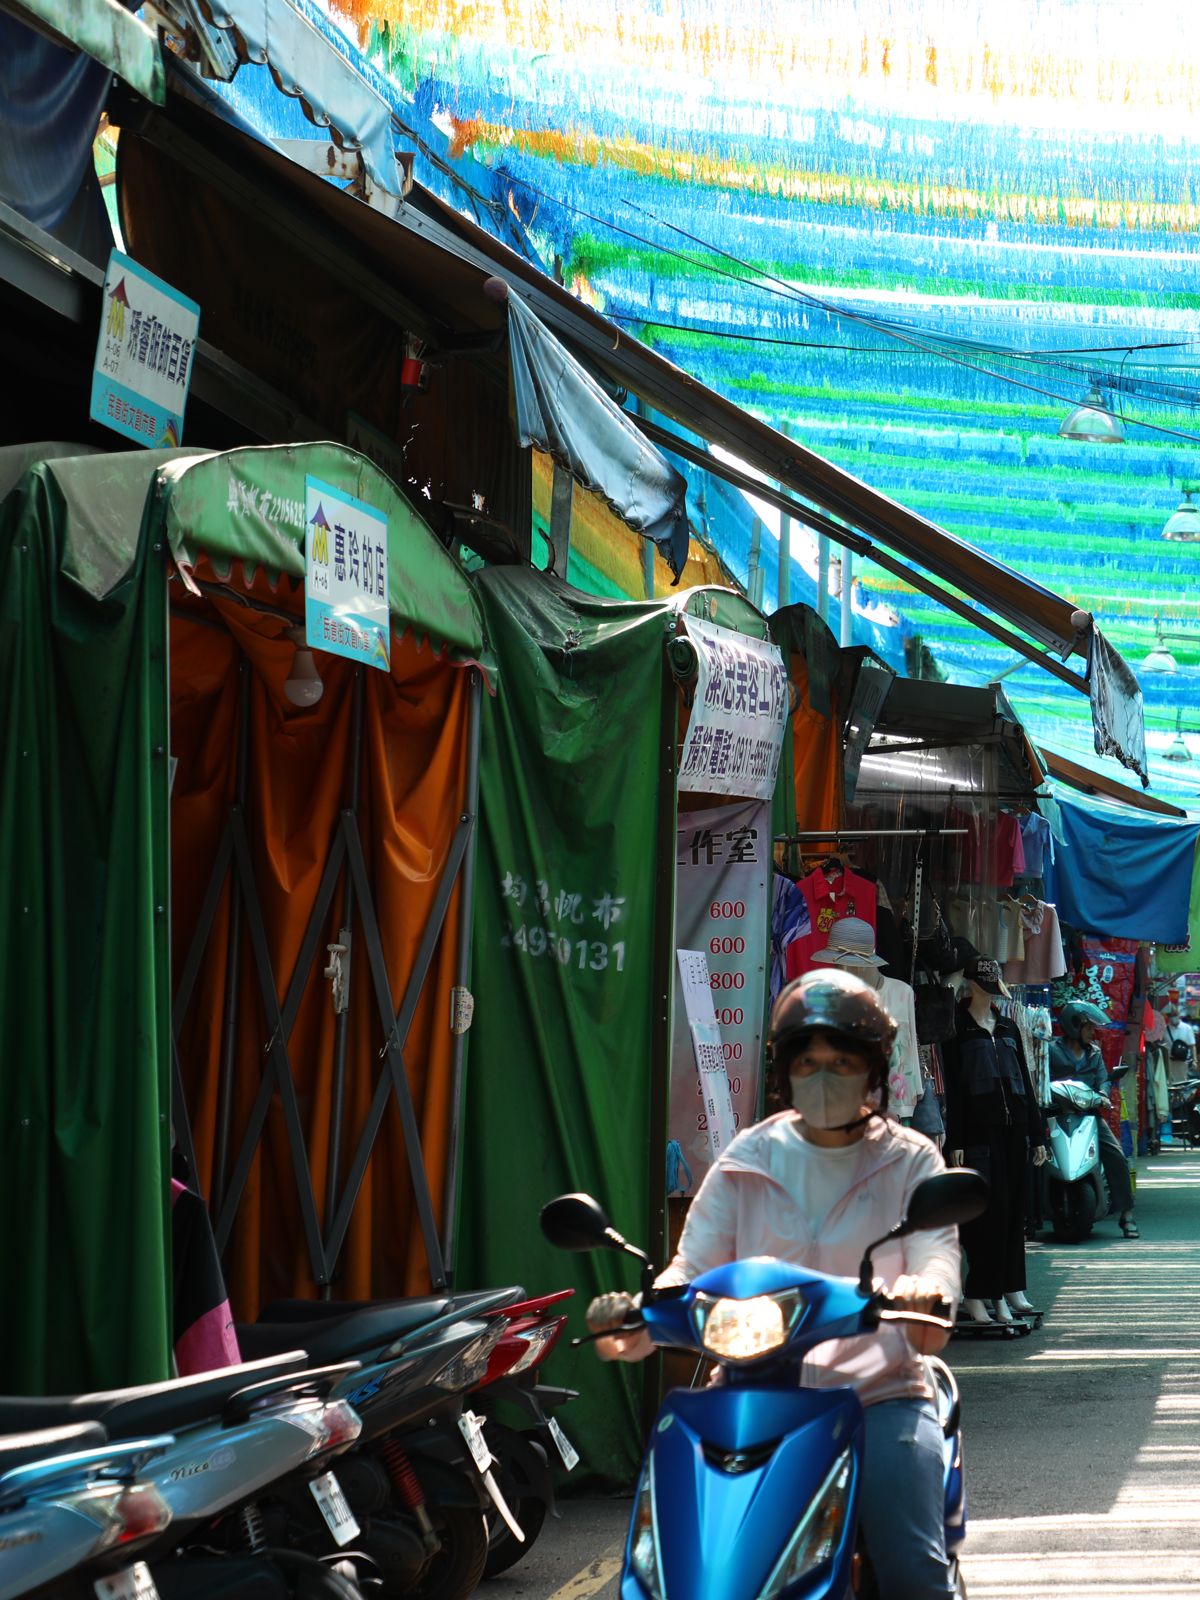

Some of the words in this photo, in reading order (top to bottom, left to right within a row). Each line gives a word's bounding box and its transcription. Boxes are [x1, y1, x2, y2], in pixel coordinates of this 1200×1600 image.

[334, 522, 385, 600] 惠玲的店
[710, 901, 745, 918] 600
[710, 937, 745, 954] 600
[710, 972, 745, 990] 800
